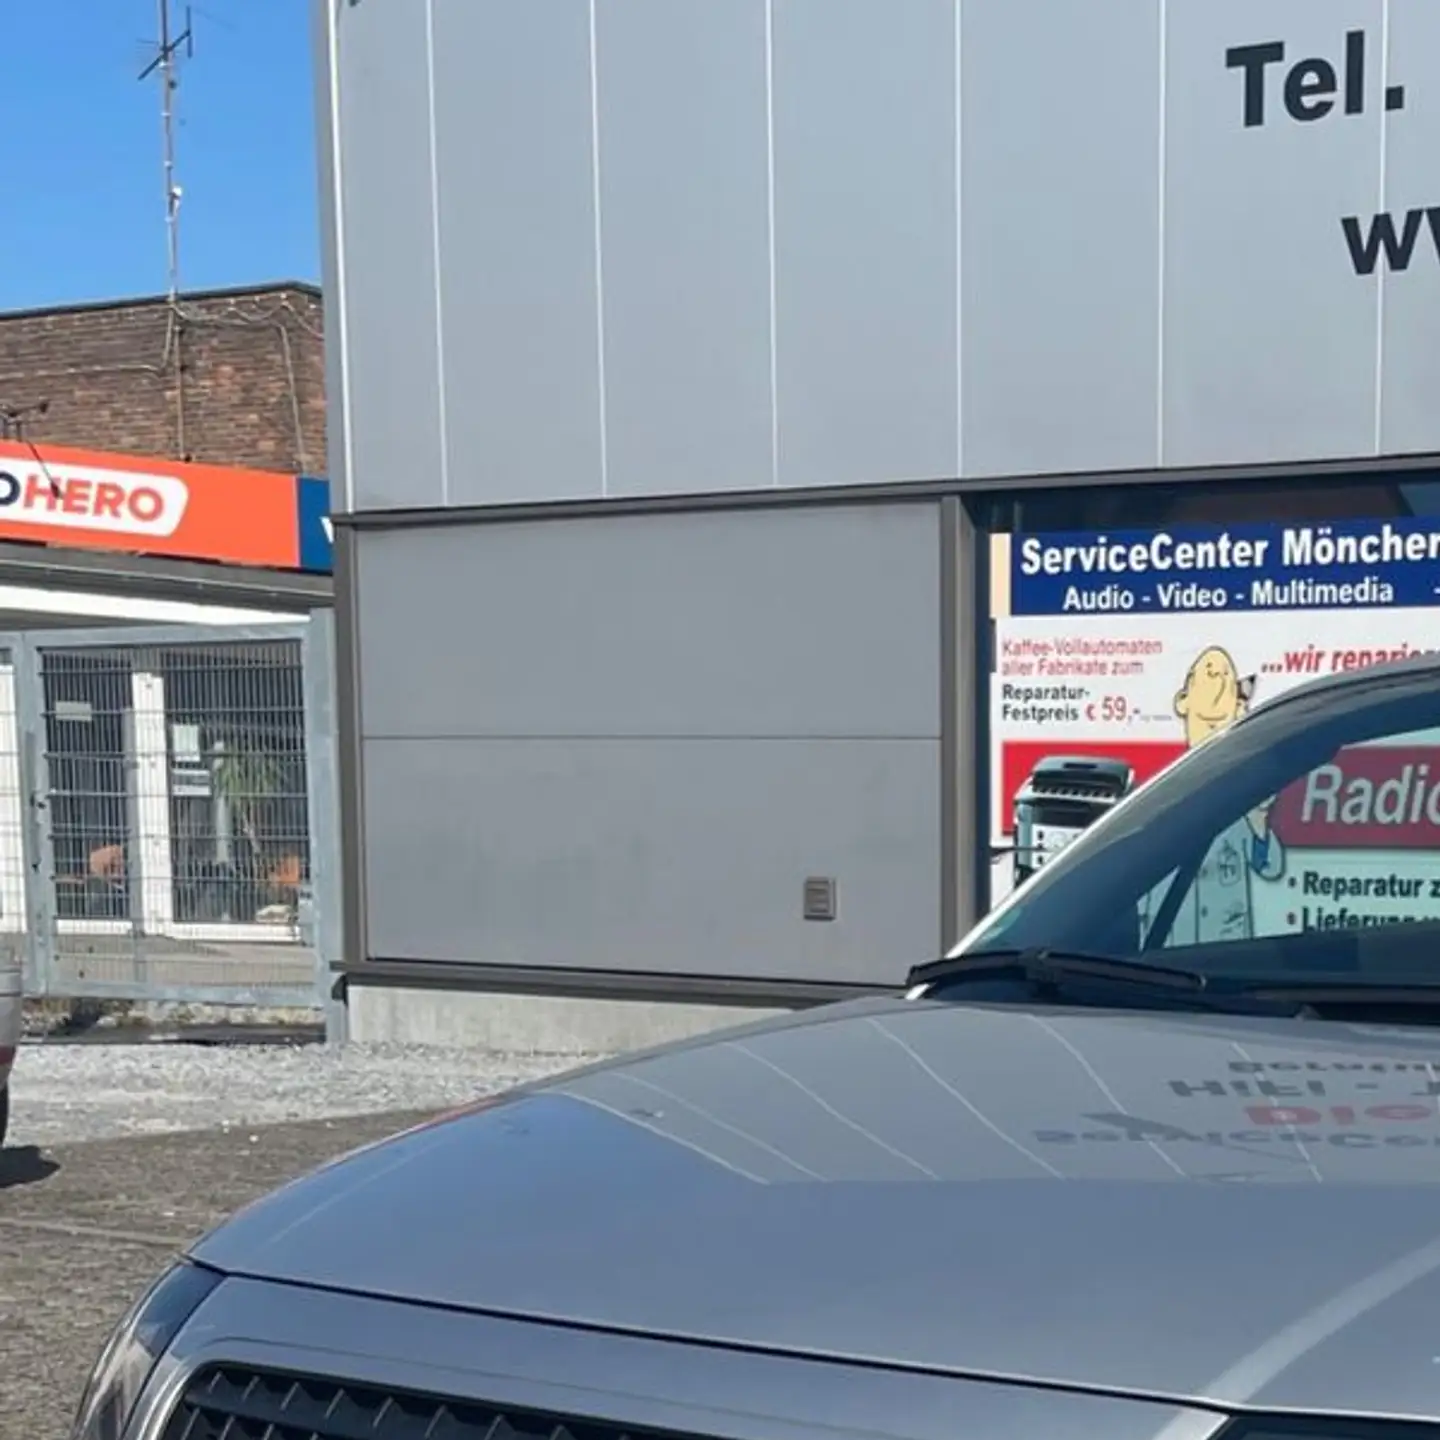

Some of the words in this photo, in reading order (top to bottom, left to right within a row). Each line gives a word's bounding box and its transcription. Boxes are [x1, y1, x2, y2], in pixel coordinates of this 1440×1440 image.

[1226, 30, 1404, 128] Tel.
[1020, 533, 1268, 576] ServiceCenter
[1063, 584, 1134, 612] Audio
[1157, 580, 1227, 609] Video
[1251, 576, 1395, 608] Multimedia
[1002, 637, 1163, 657] Kaffee-Vollautomaten
[1002, 660, 1034, 676] aller
[1038, 659, 1108, 676] Fabrikate
[1111, 662, 1144, 676] zum
[1002, 683, 1091, 703] Reparatur-
[1002, 704, 1079, 726] Festpreis
[1302, 870, 1425, 901] Reparatur
